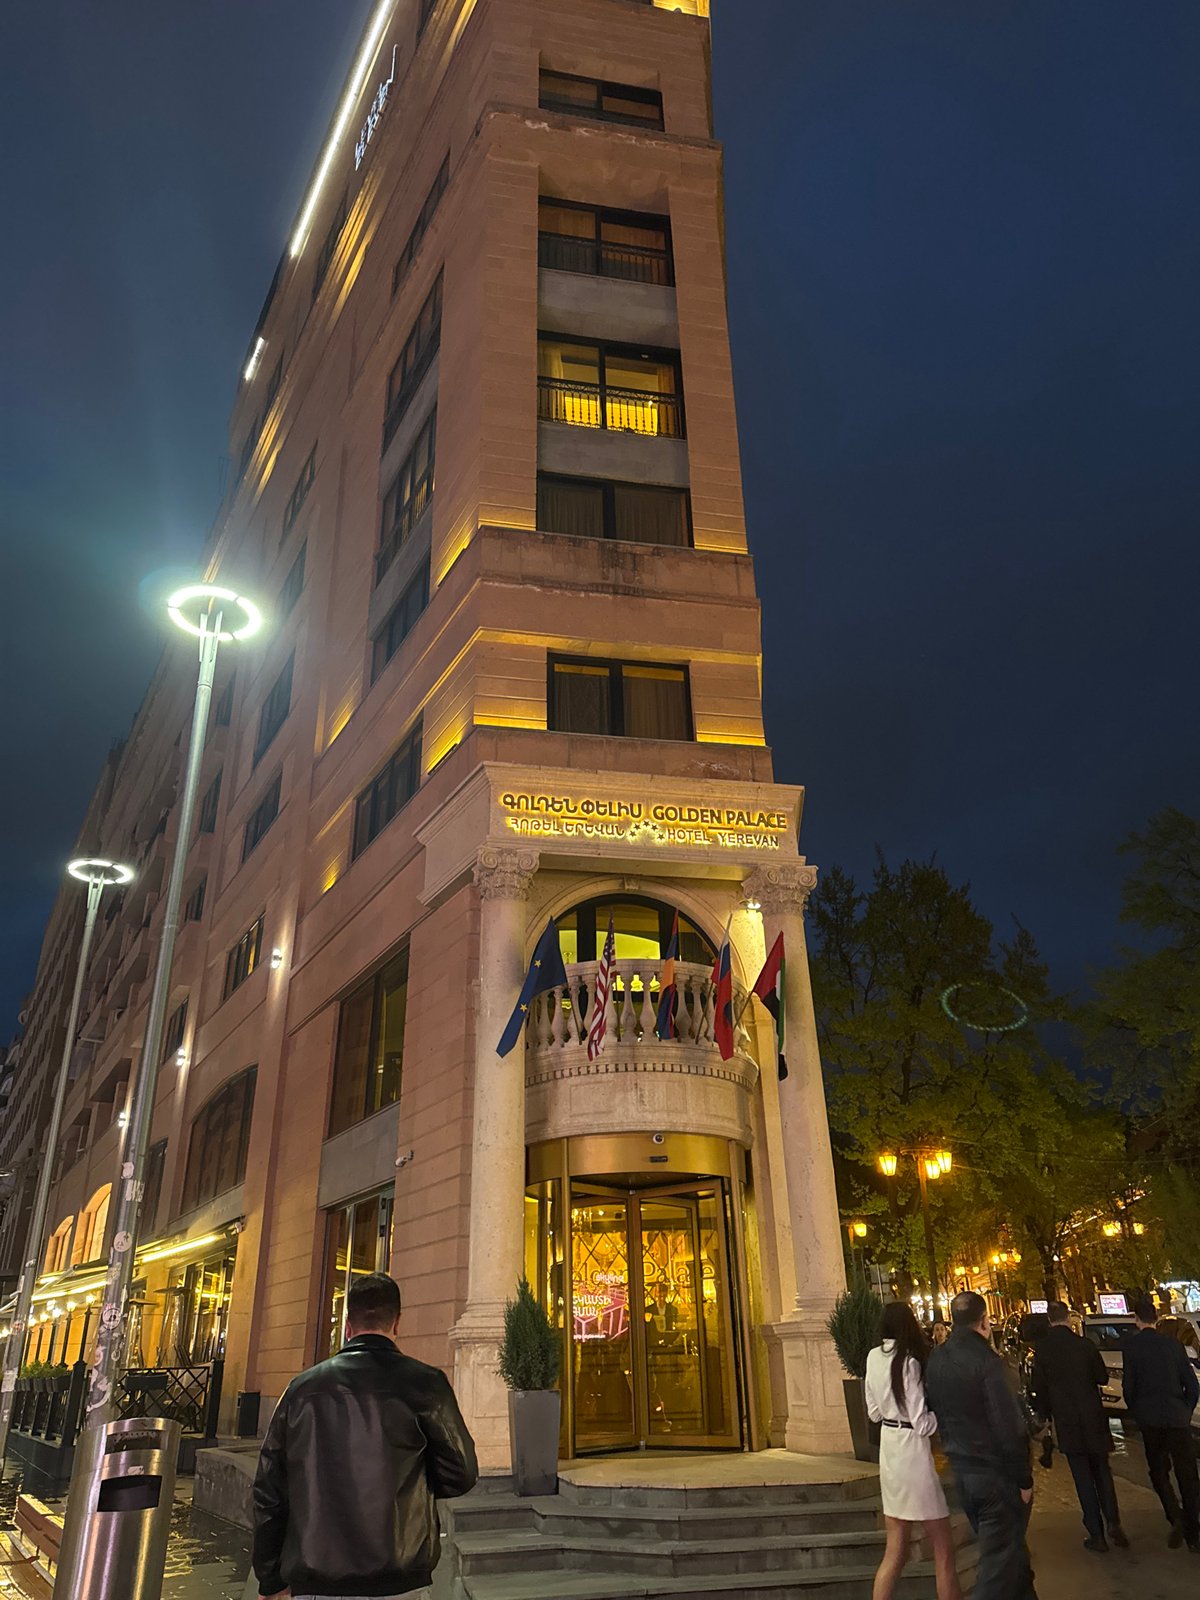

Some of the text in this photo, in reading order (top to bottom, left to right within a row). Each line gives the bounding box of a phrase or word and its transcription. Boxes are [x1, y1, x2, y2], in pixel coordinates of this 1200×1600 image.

[502, 793, 642, 818] ԳՈԼԴԵՆ ՓԵԼԻՍ
[510, 817, 625, 835] ՀՈԹԵԼ ԵՐԵՎԱՆ
[652, 805, 787, 829] GOLDEN PALACE
[667, 828, 779, 847] HOTEL YEREVAN
